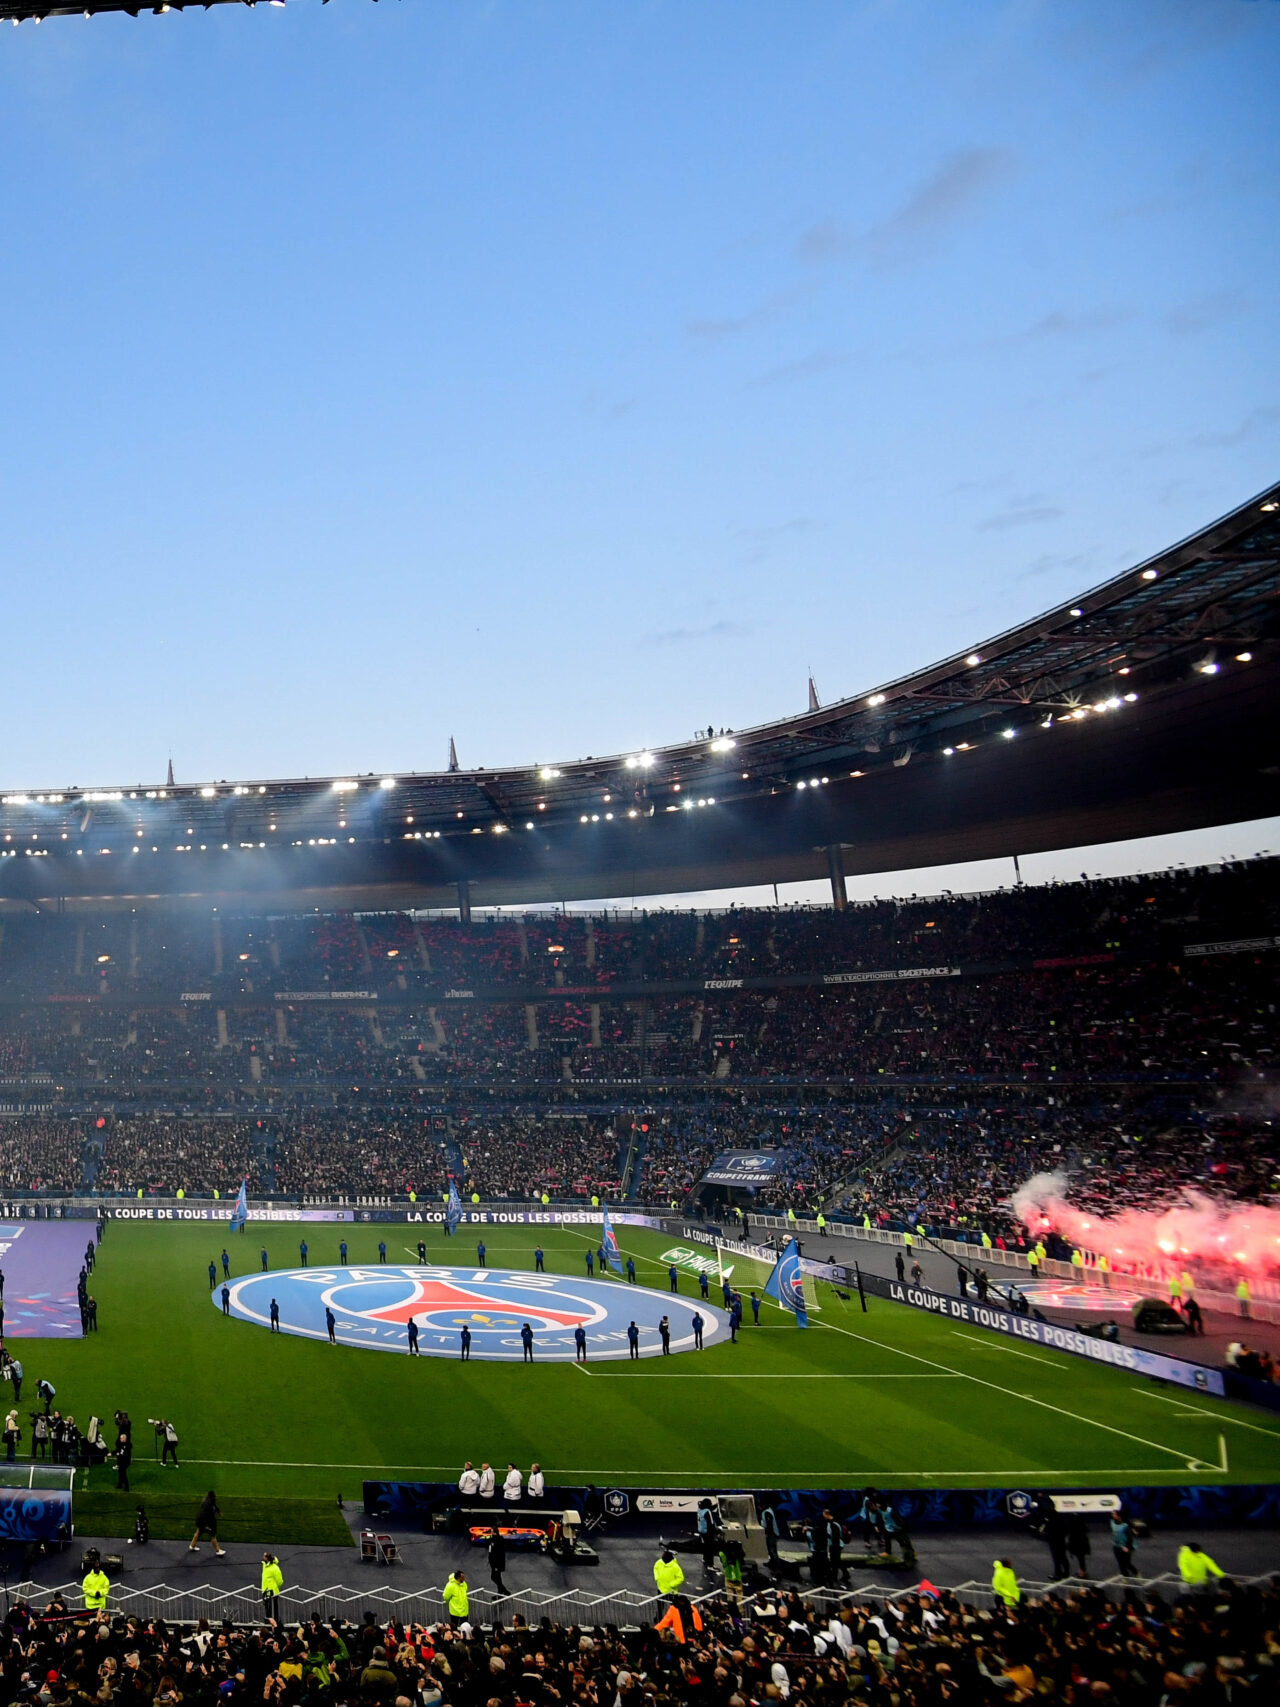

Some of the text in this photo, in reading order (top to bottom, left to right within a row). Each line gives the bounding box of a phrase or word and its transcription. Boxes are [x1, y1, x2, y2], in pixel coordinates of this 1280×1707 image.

[303, 1195, 392, 1207] COUPE DE FRANCE
[115, 1208, 154, 1219] COUPE
[157, 1209, 173, 1219] DE
[176, 1209, 208, 1220] TOUS
[211, 1209, 233, 1220] LES
[245, 1209, 301, 1221] OSSIBLES
[407, 1212, 423, 1222] LA
[471, 1213, 488, 1223] DE
[491, 1212, 525, 1223] TOUS
[528, 1213, 551, 1223] LES
[683, 1227, 692, 1238] LA
[693, 1230, 715, 1246] COUPE
[726, 1239, 745, 1254] TOUS
[289, 1268, 561, 1288] PARIS
[890, 1283, 1136, 1368] LA COUPE DE TOUS LES POSSIBLES
